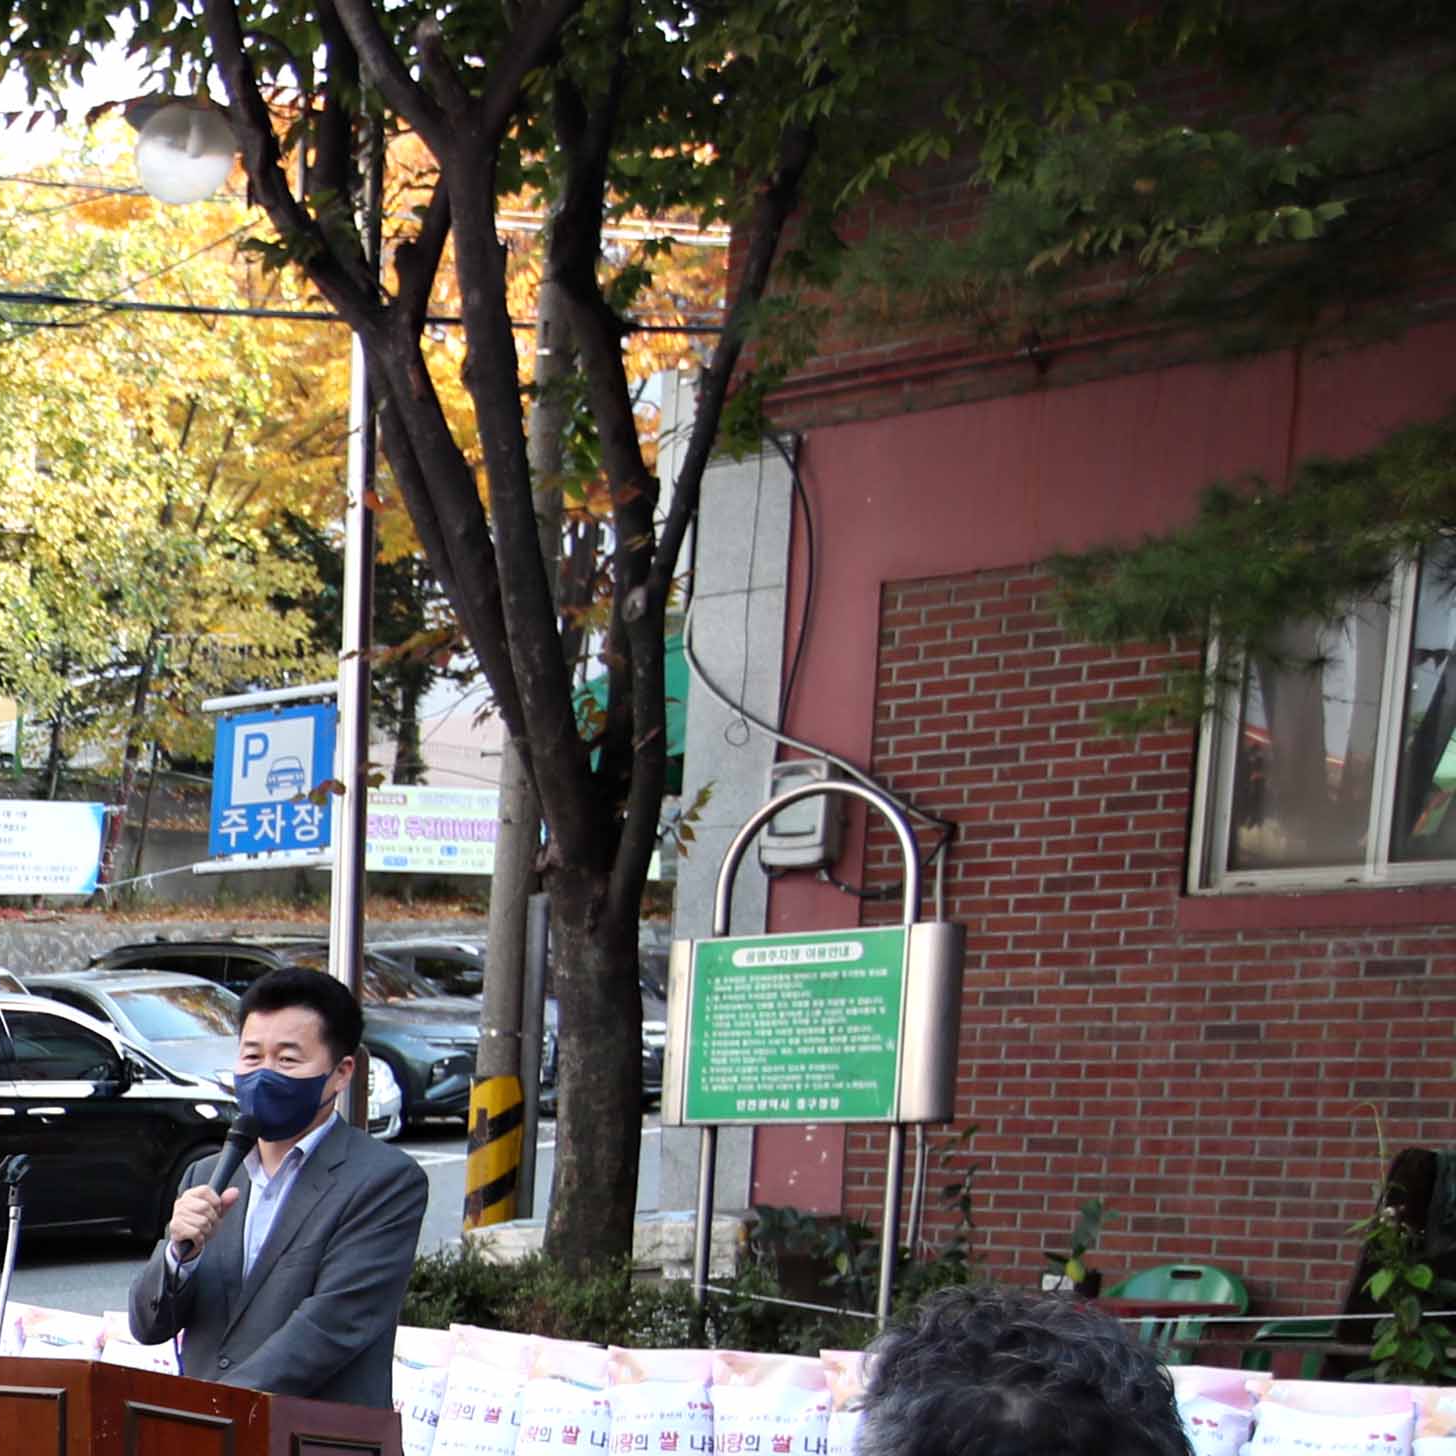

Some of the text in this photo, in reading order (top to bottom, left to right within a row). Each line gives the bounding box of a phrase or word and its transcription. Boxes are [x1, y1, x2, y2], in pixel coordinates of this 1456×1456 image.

[241, 731, 269, 778] P
[219, 803, 324, 848] 주차장
[561, 1424, 581, 1446] 쌀
[659, 1430, 680, 1452] 쌀
[771, 1433, 794, 1454] 쌀
